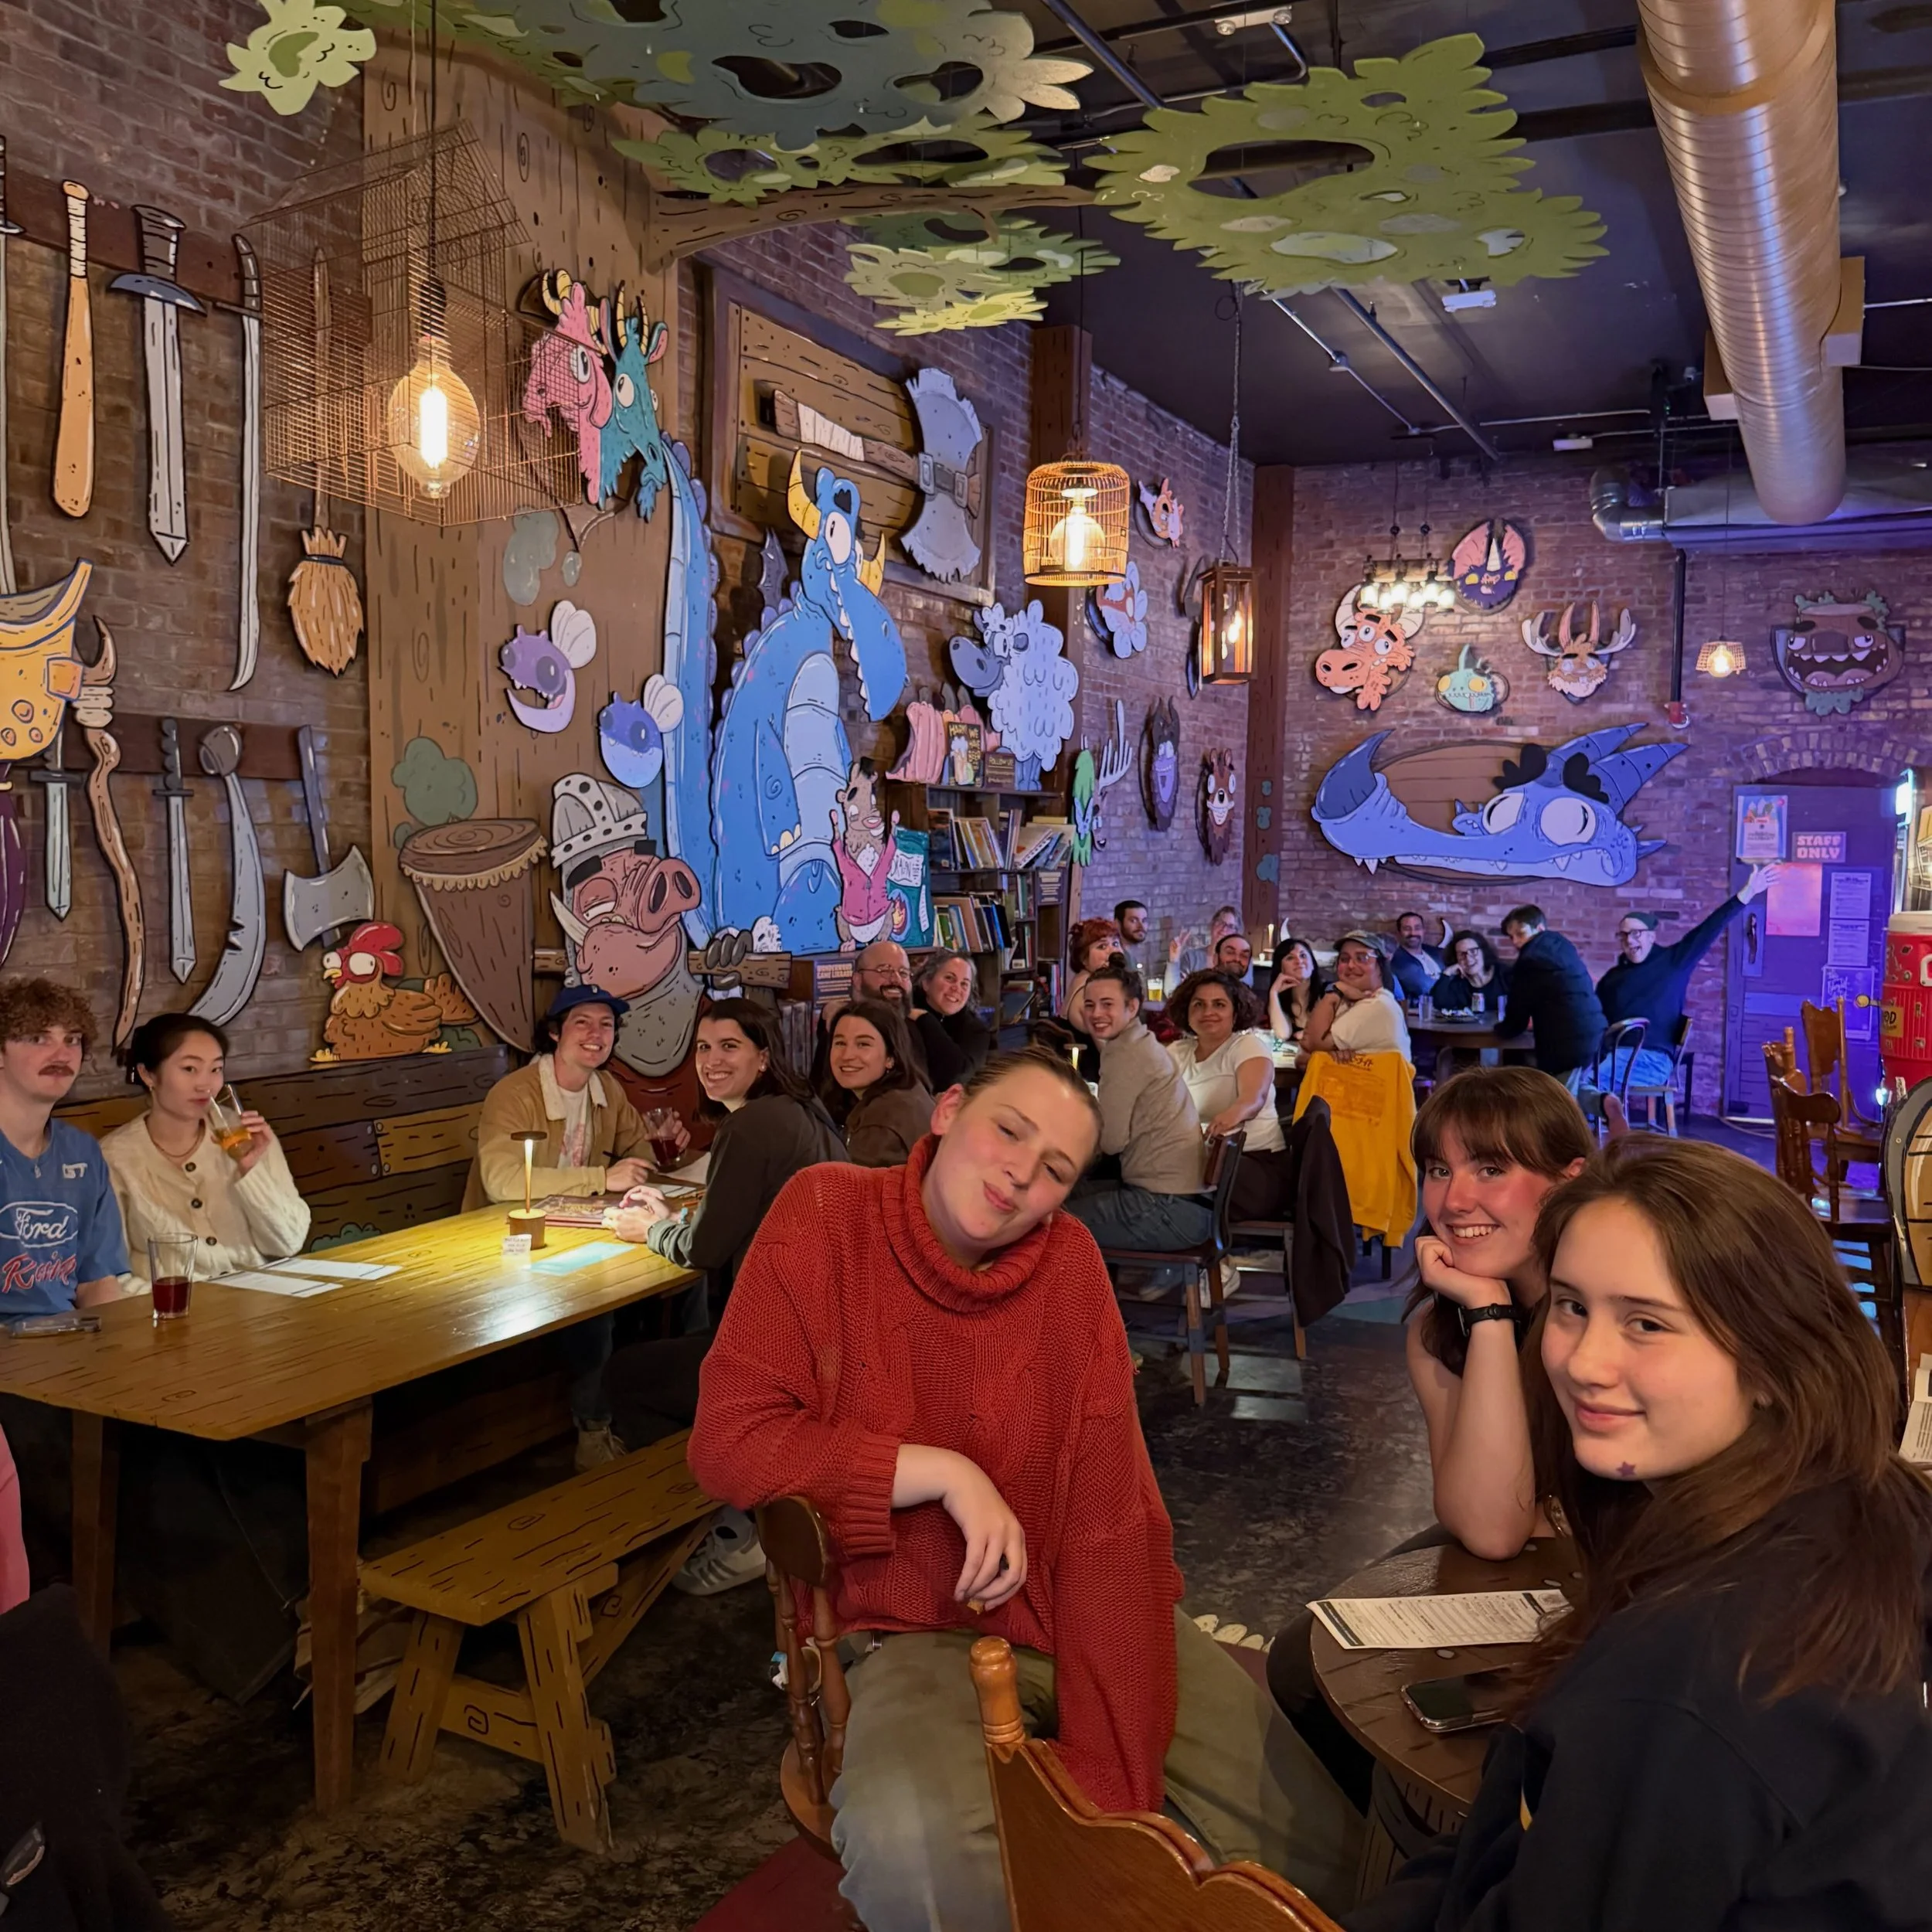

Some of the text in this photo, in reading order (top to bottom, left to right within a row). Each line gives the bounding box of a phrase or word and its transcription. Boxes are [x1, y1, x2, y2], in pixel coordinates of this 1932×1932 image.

[1797, 835, 1842, 845] STAFF
[1797, 847, 1841, 859] ONLY
[15, 1206, 70, 1240] Ford
